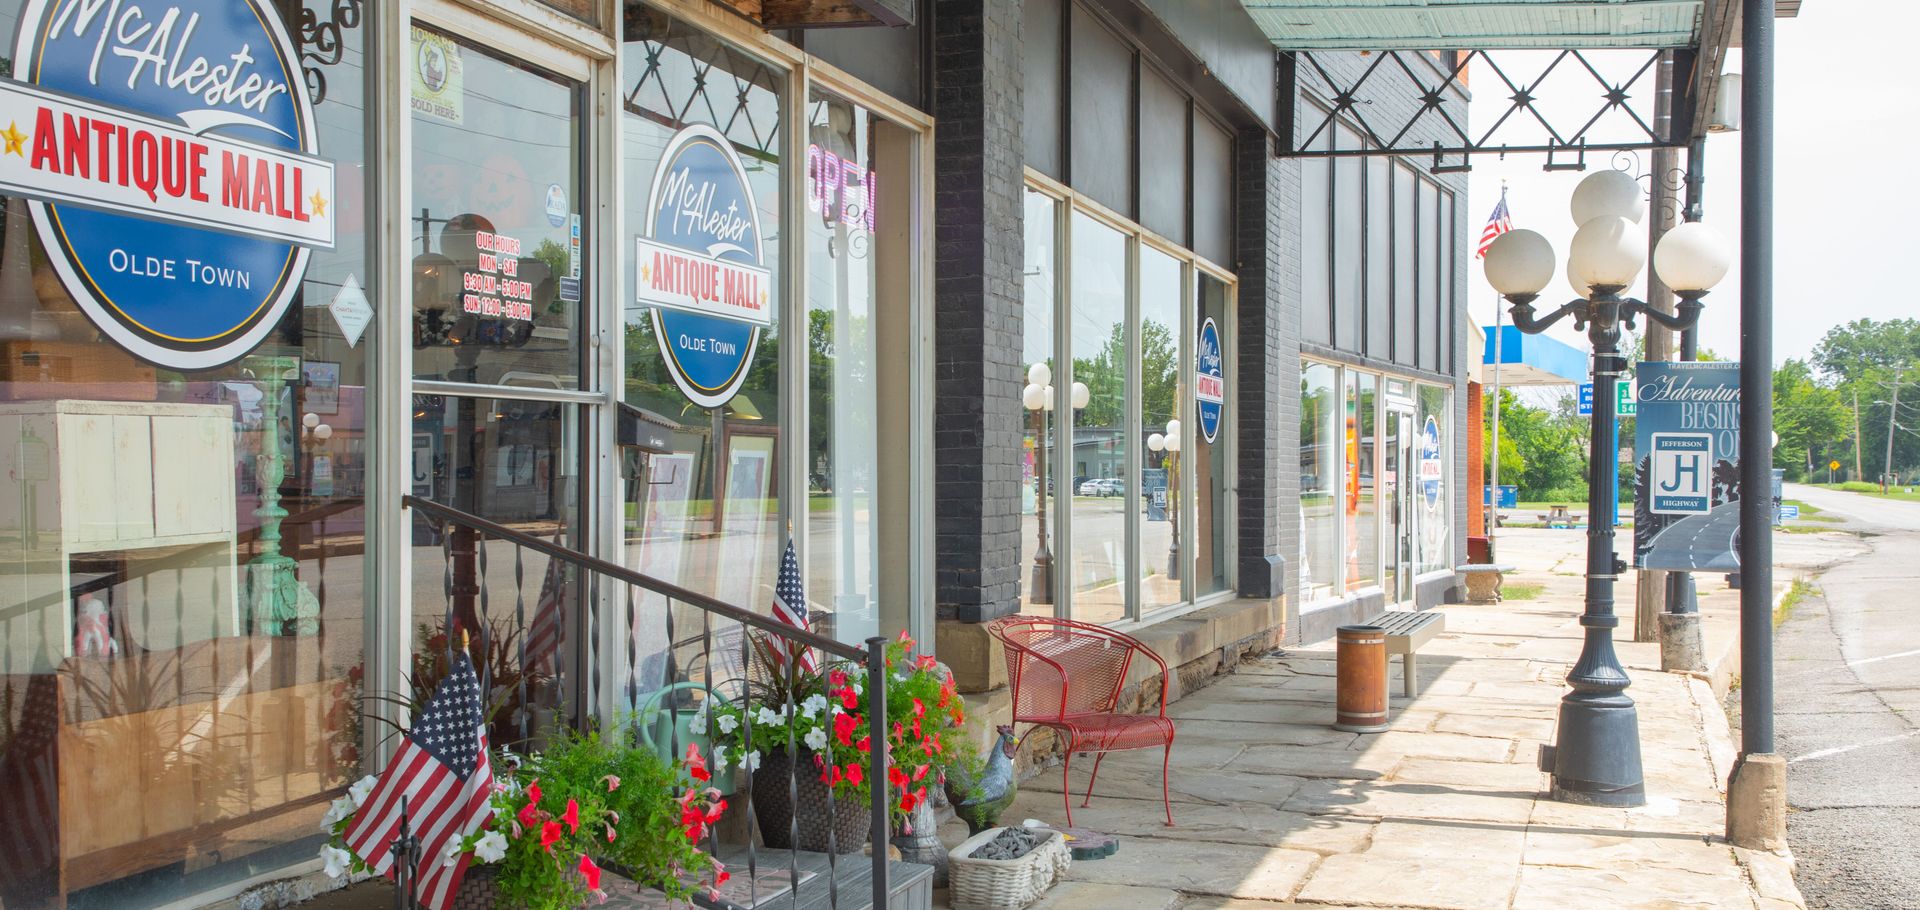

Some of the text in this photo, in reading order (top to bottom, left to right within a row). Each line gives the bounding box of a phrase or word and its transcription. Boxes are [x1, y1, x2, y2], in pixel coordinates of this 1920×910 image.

[50, 0, 287, 112] McAlester
[411, 97, 432, 113] SOLD
[30, 106, 310, 223] ANTIQUE MALL
[659, 166, 751, 242] McAlester
[808, 143, 876, 235] OPEN
[476, 231, 520, 256] OUR HOURS
[479, 252, 497, 273] MON
[503, 257, 518, 277] SAT
[652, 251, 760, 310] ANTIQUE MALL
[464, 272, 483, 292] 9:30
[483, 275, 496, 295] AM
[502, 278, 519, 298] 5:00
[520, 281, 532, 300] PM
[520, 302, 532, 321] PM
[1638, 374, 1740, 402] Adventur
[1660, 455, 1699, 492] JH
